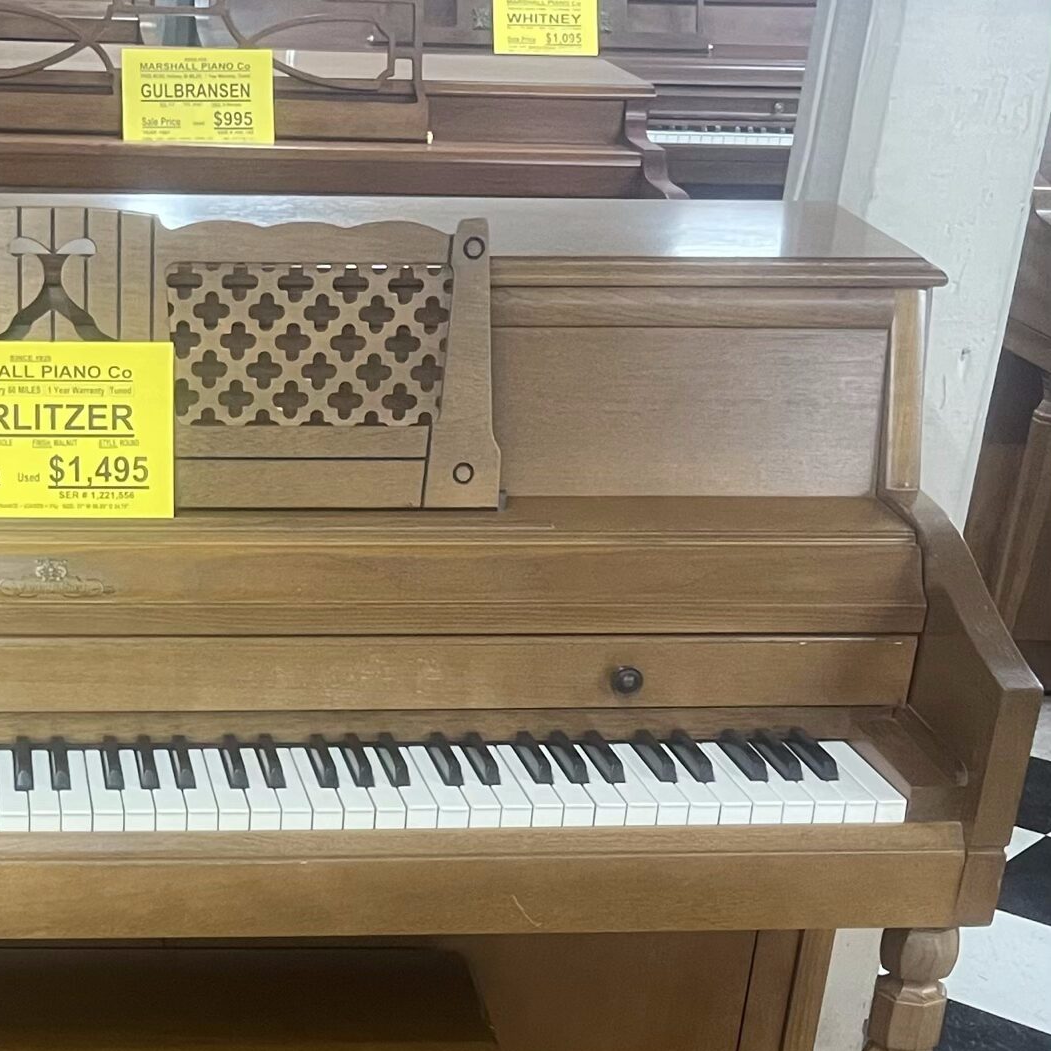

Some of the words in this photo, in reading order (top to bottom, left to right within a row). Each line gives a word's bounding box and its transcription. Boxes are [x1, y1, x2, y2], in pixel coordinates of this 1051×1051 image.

[507, 13, 581, 24] WHITNEY
[546, 33, 582, 45] $1,095
[140, 62, 198, 71] MARSHALL
[201, 62, 234, 71] PIANO
[237, 62, 251, 71] Co
[141, 83, 251, 98] GULBRANSEN
[142, 117, 159, 127] Sale
[161, 117, 181, 127] Price
[214, 111, 253, 127] $995
[41, 365, 101, 379] PIANO
[108, 365, 133, 379] Co
[18, 386, 41, 394] MILES
[54, 386, 70, 394] Year
[72, 386, 105, 397] Warranty
[109, 386, 132, 394] Tuned
[17, 472, 41, 483] Used
[49, 454, 149, 487] $1,495
[59, 491, 79, 499] SER
